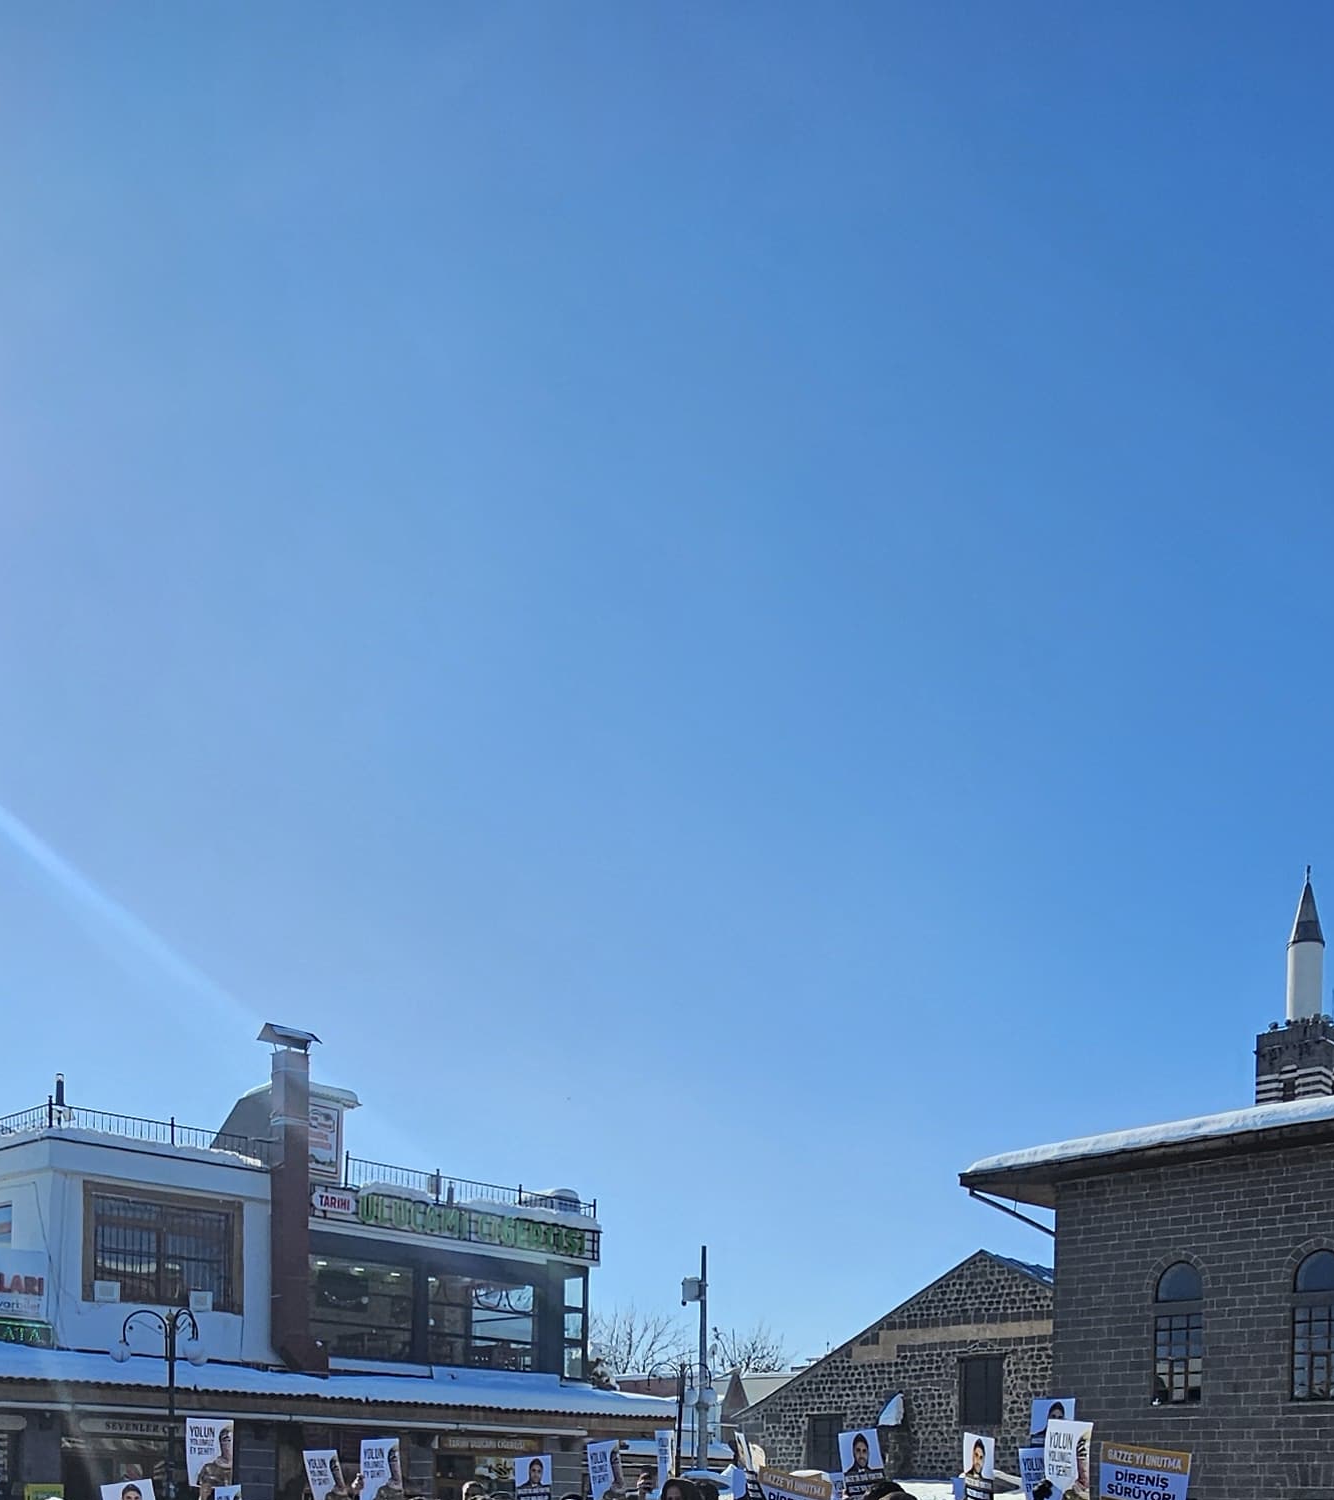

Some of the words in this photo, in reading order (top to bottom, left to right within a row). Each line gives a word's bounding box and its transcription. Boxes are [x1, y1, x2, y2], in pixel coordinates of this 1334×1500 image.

[105, 1421, 159, 1433] SEVENLER
[189, 1426, 216, 1438] YOLUN
[1049, 1432, 1074, 1450] YOLUN
[1115, 1469, 1169, 1492] DİRENİŞ
